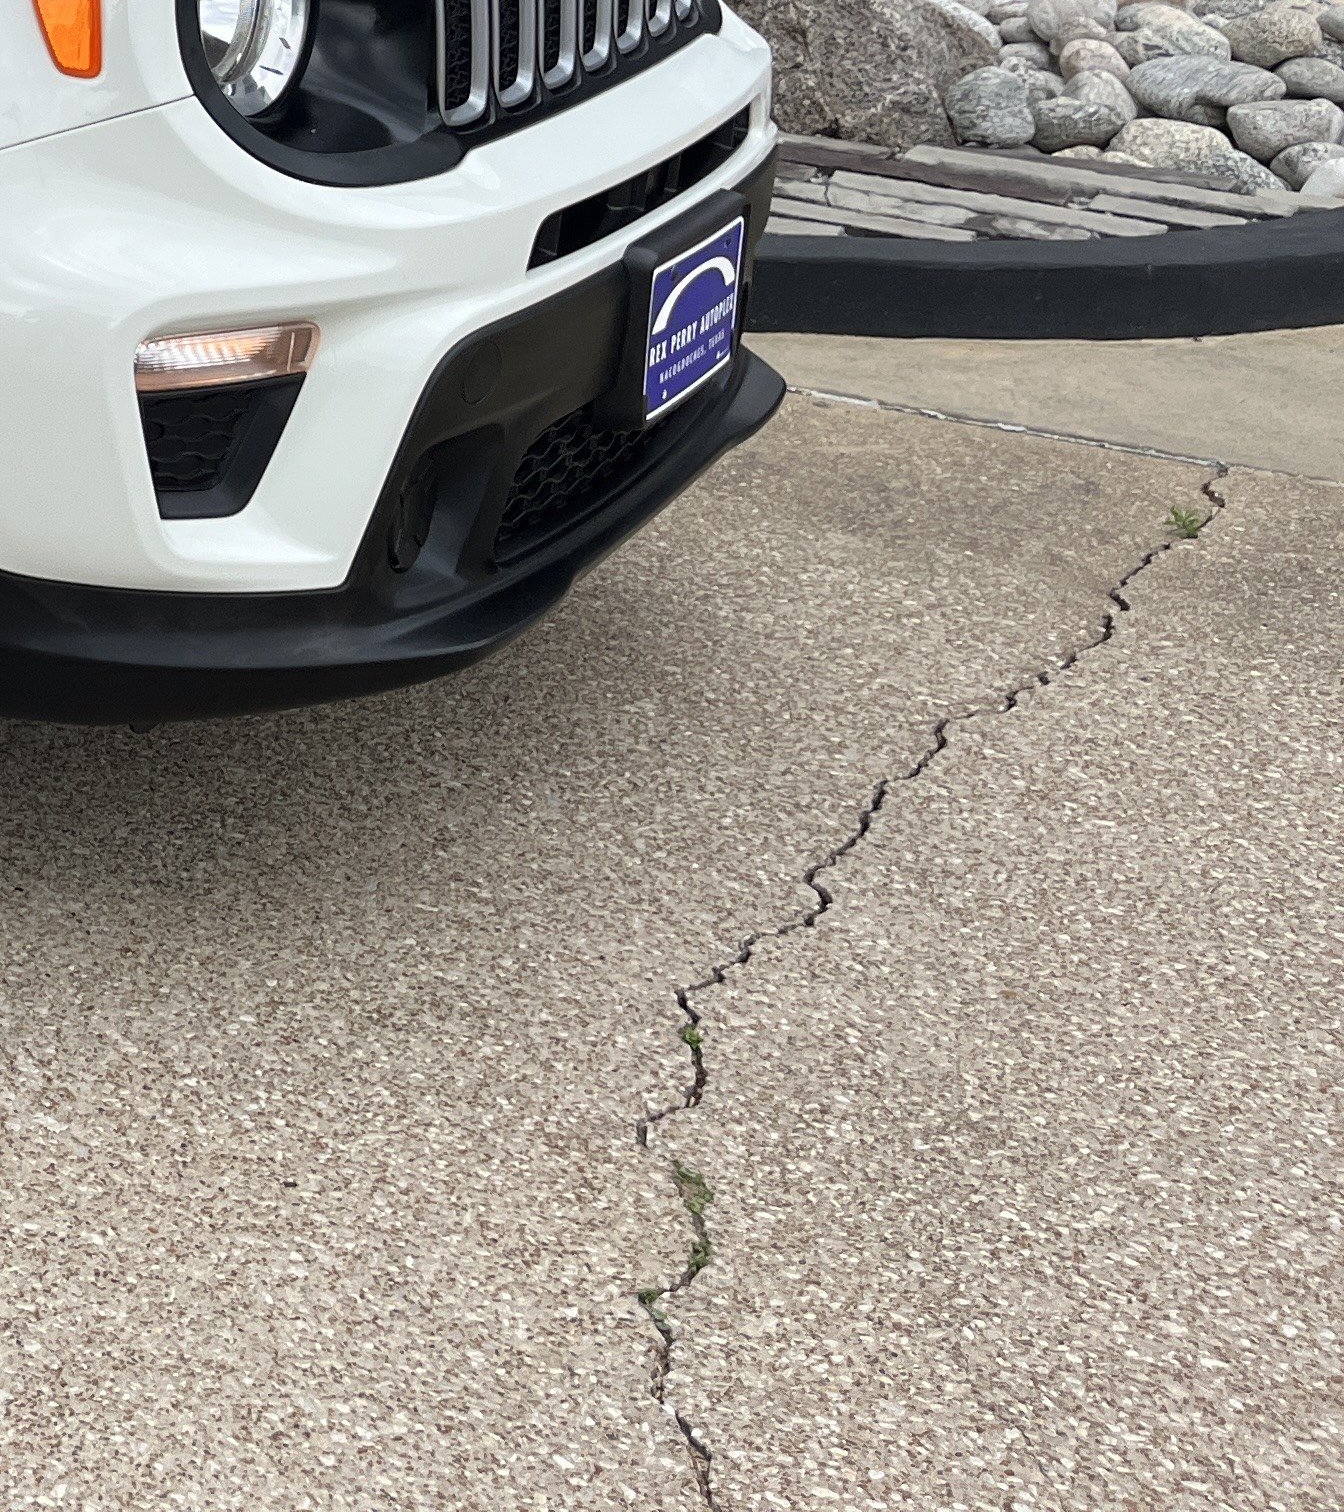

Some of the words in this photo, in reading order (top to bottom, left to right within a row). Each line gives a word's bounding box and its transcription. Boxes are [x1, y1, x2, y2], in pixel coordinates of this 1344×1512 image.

[649, 339, 668, 367] REX
[670, 320, 698, 354] PERRY
[700, 292, 735, 335] AUTOPLEX
